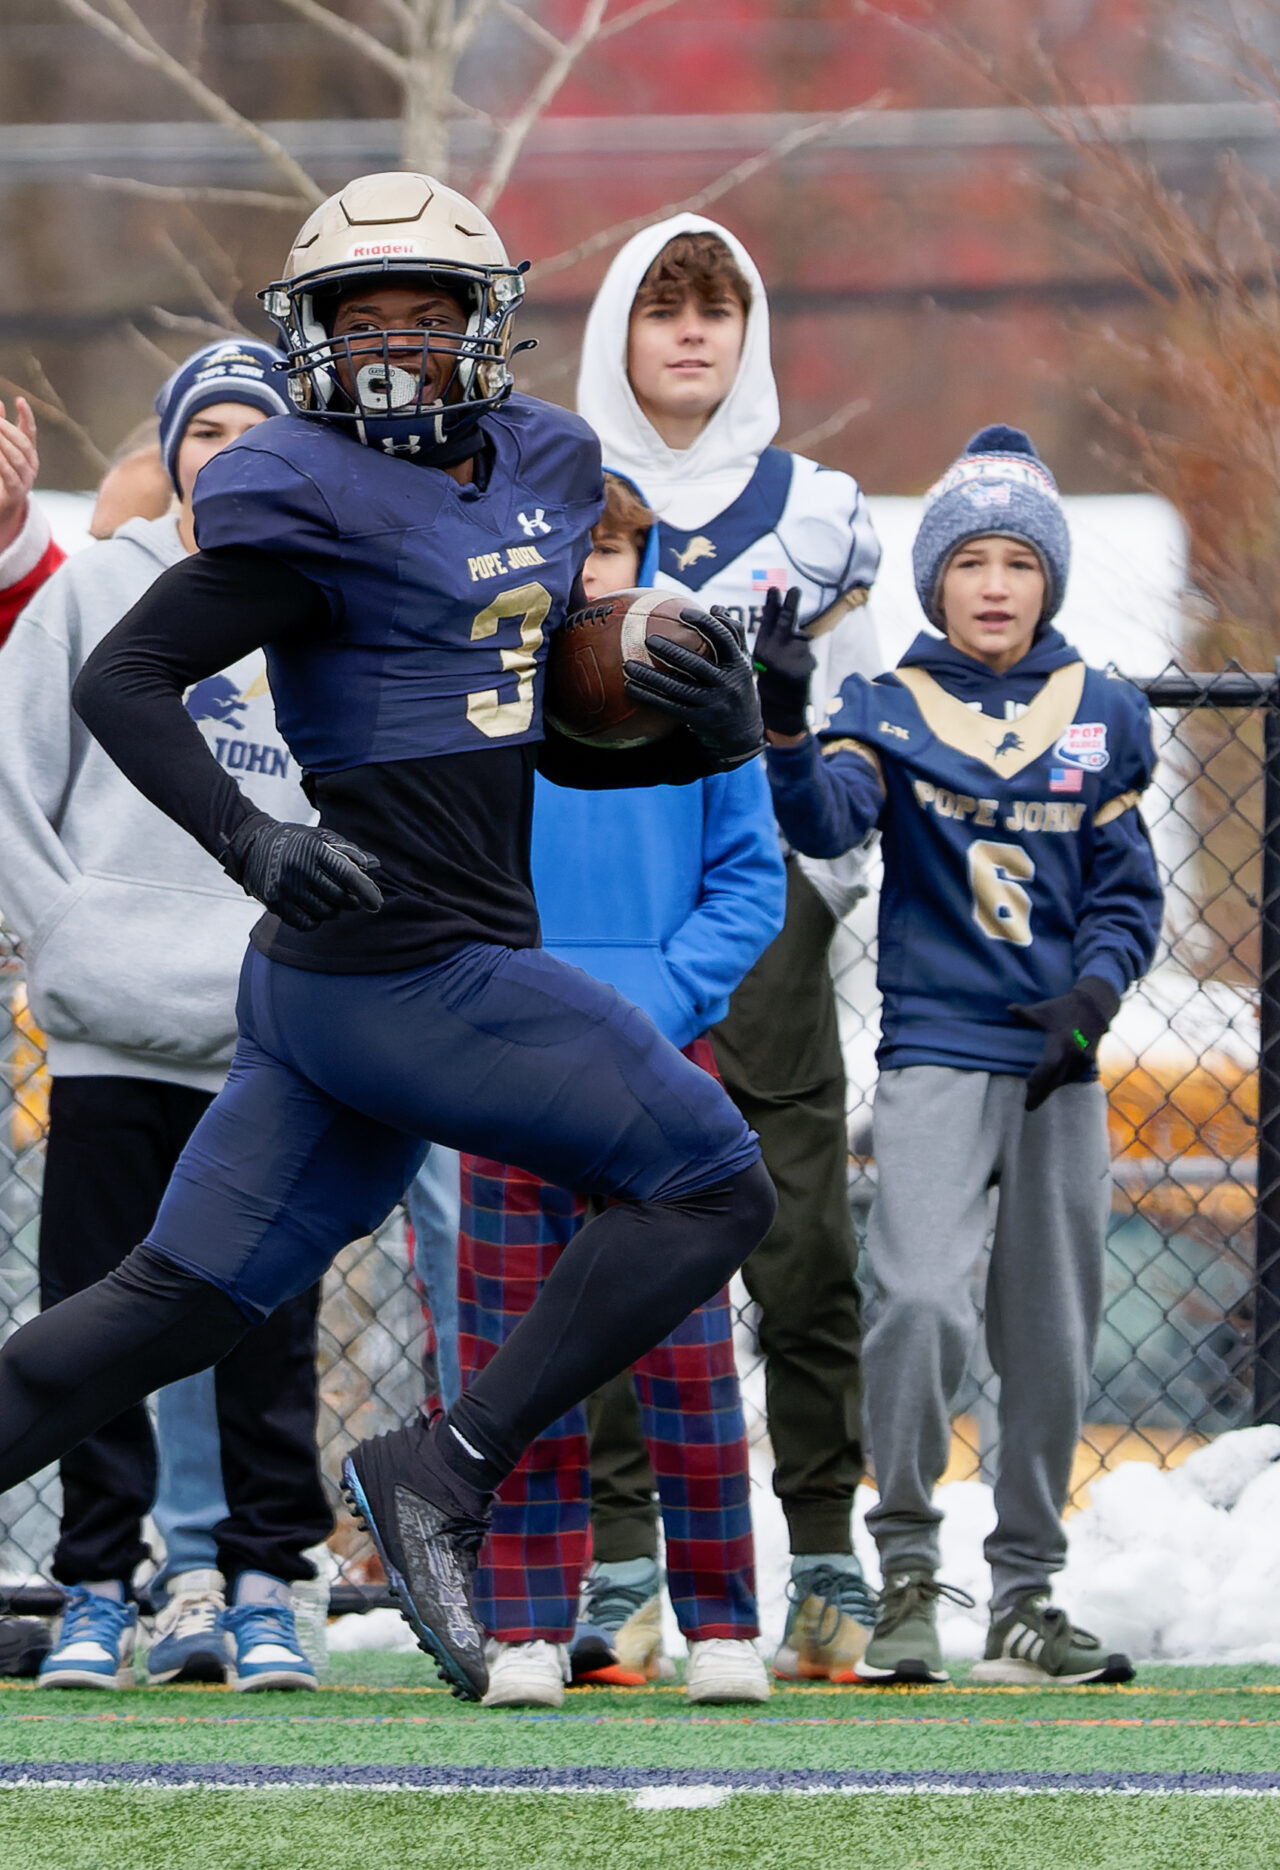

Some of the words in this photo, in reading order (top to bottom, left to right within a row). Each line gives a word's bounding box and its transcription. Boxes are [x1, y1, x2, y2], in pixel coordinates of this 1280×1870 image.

[467, 552, 509, 582] POPE
[506, 545, 547, 569] JOHN
[466, 581, 552, 738] 3
[914, 780, 999, 827] POPE
[1005, 800, 1087, 833] JOHN
[967, 839, 1036, 947] 6
